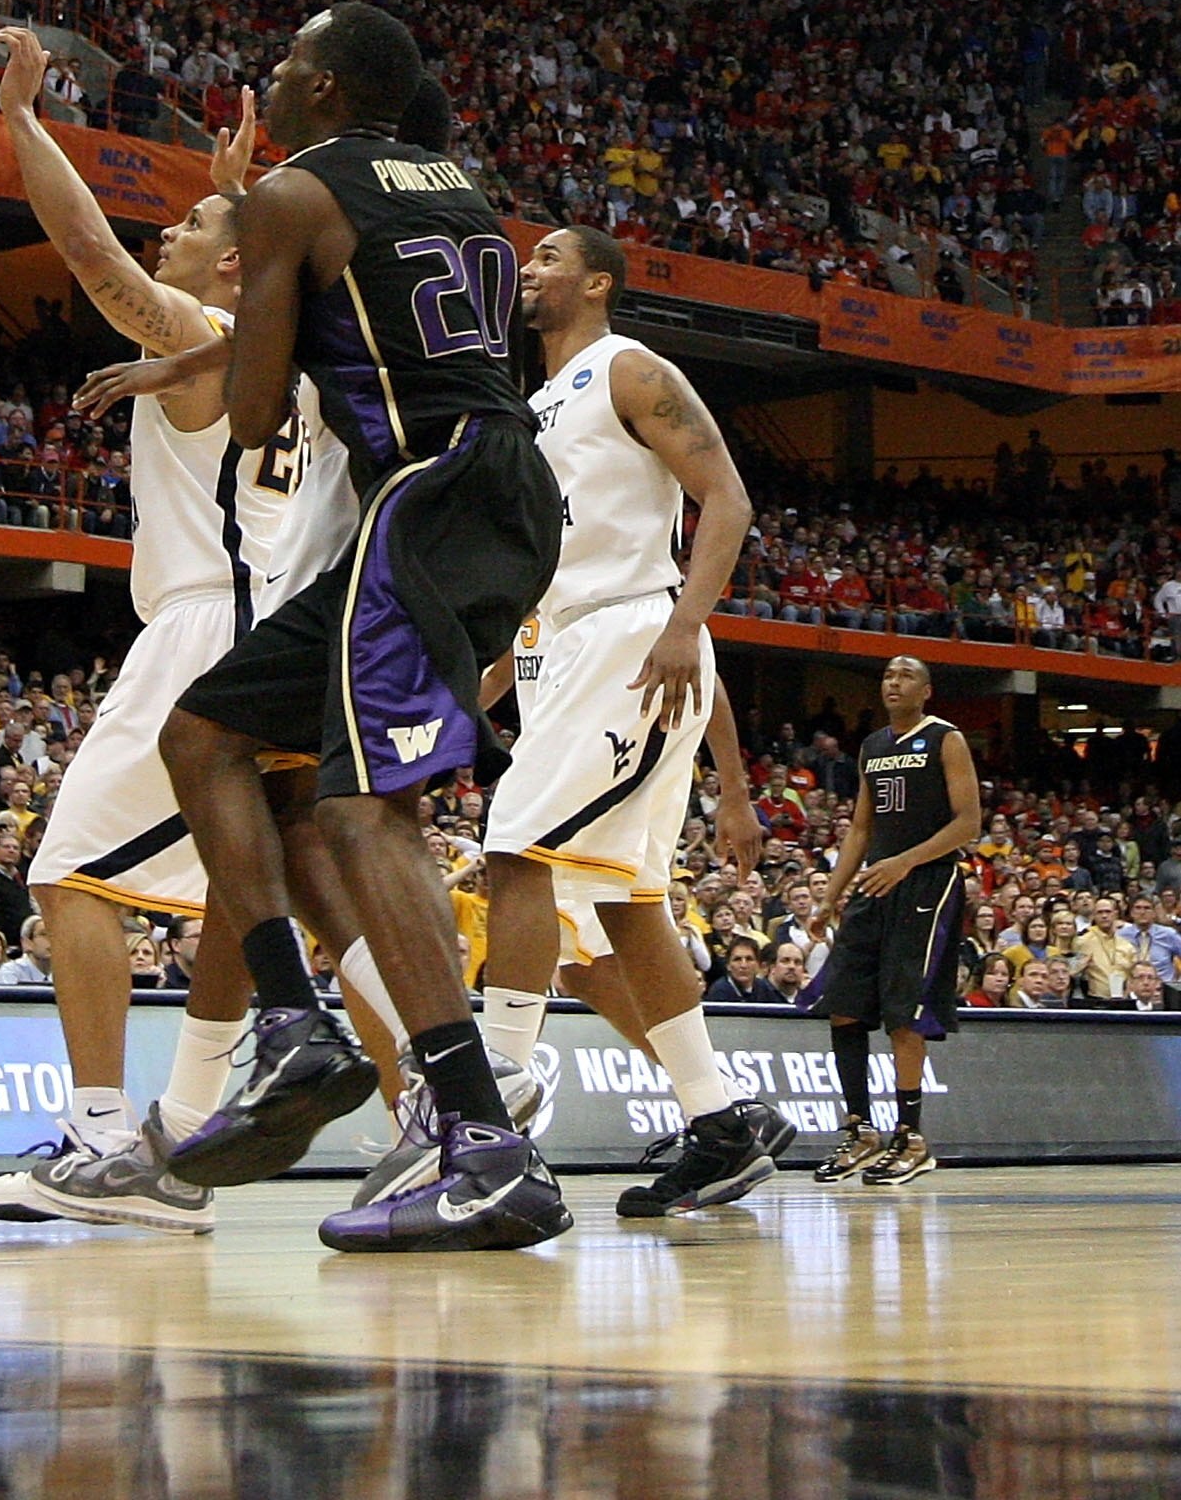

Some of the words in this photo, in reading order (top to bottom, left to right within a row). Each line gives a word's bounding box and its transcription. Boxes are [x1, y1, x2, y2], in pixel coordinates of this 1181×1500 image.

[99, 148, 152, 174] NCAA
[394, 234, 518, 358] 20
[387, 717, 443, 764] W
[864, 753, 929, 774] HUSKIES
[875, 776, 906, 813] 31
[778, 1100, 838, 1132] NEW
